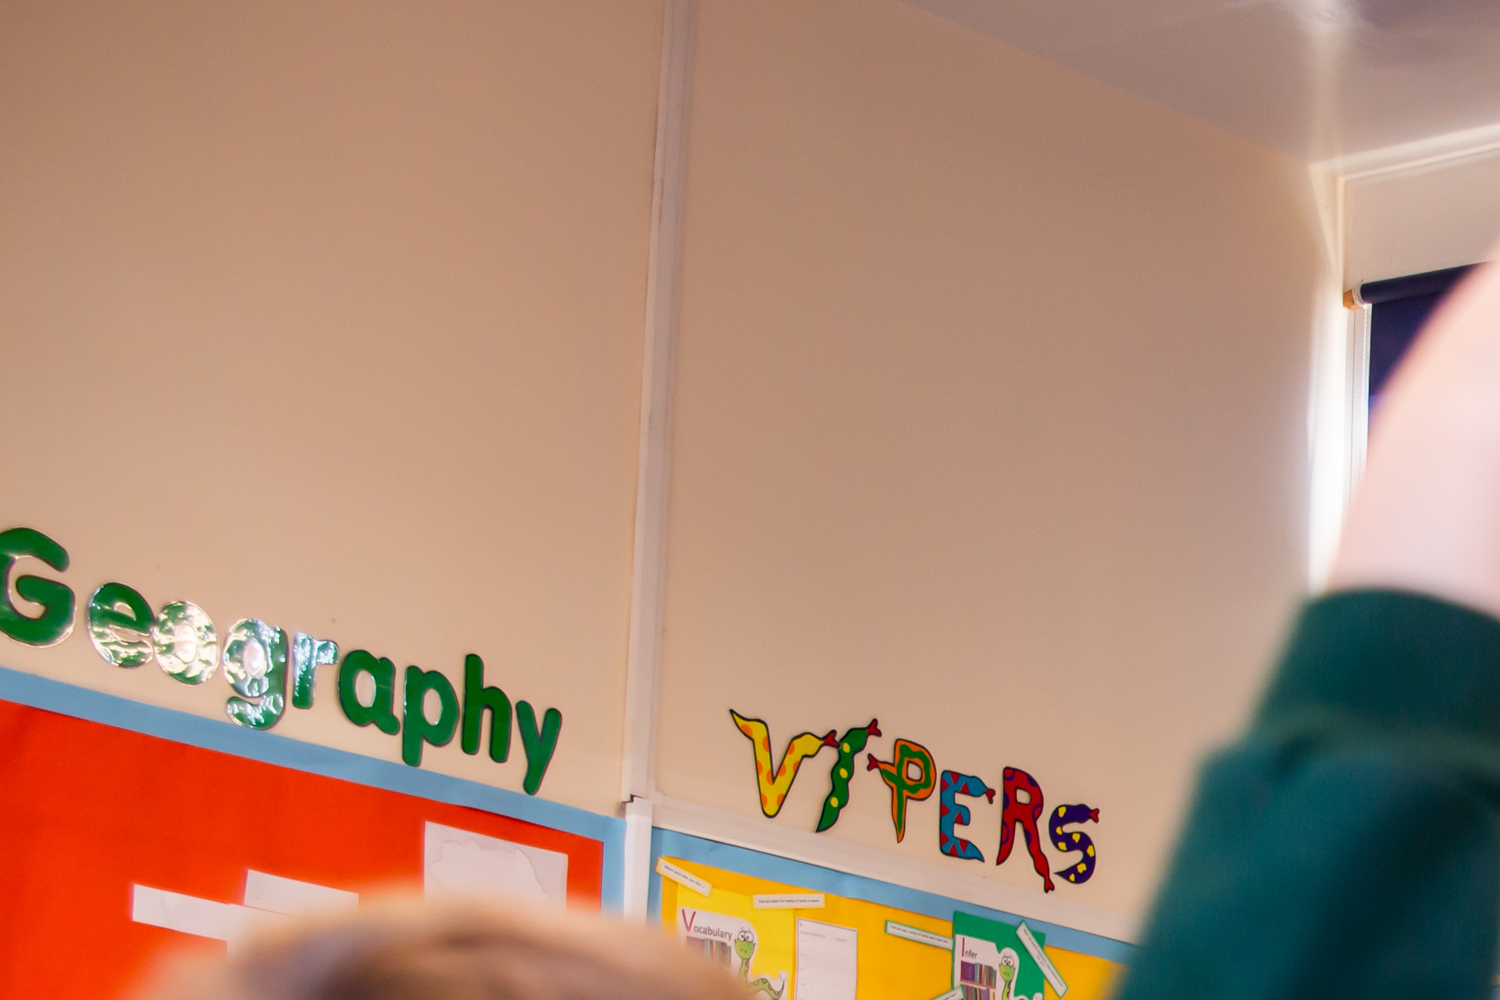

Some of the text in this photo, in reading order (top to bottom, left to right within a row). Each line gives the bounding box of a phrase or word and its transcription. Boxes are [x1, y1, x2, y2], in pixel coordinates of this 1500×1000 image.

[0, 527, 563, 795] Geography
[729, 709, 1102, 894] VIPERS
[682, 909, 732, 941] Vocabulary
[962, 937, 977, 959] Infer
